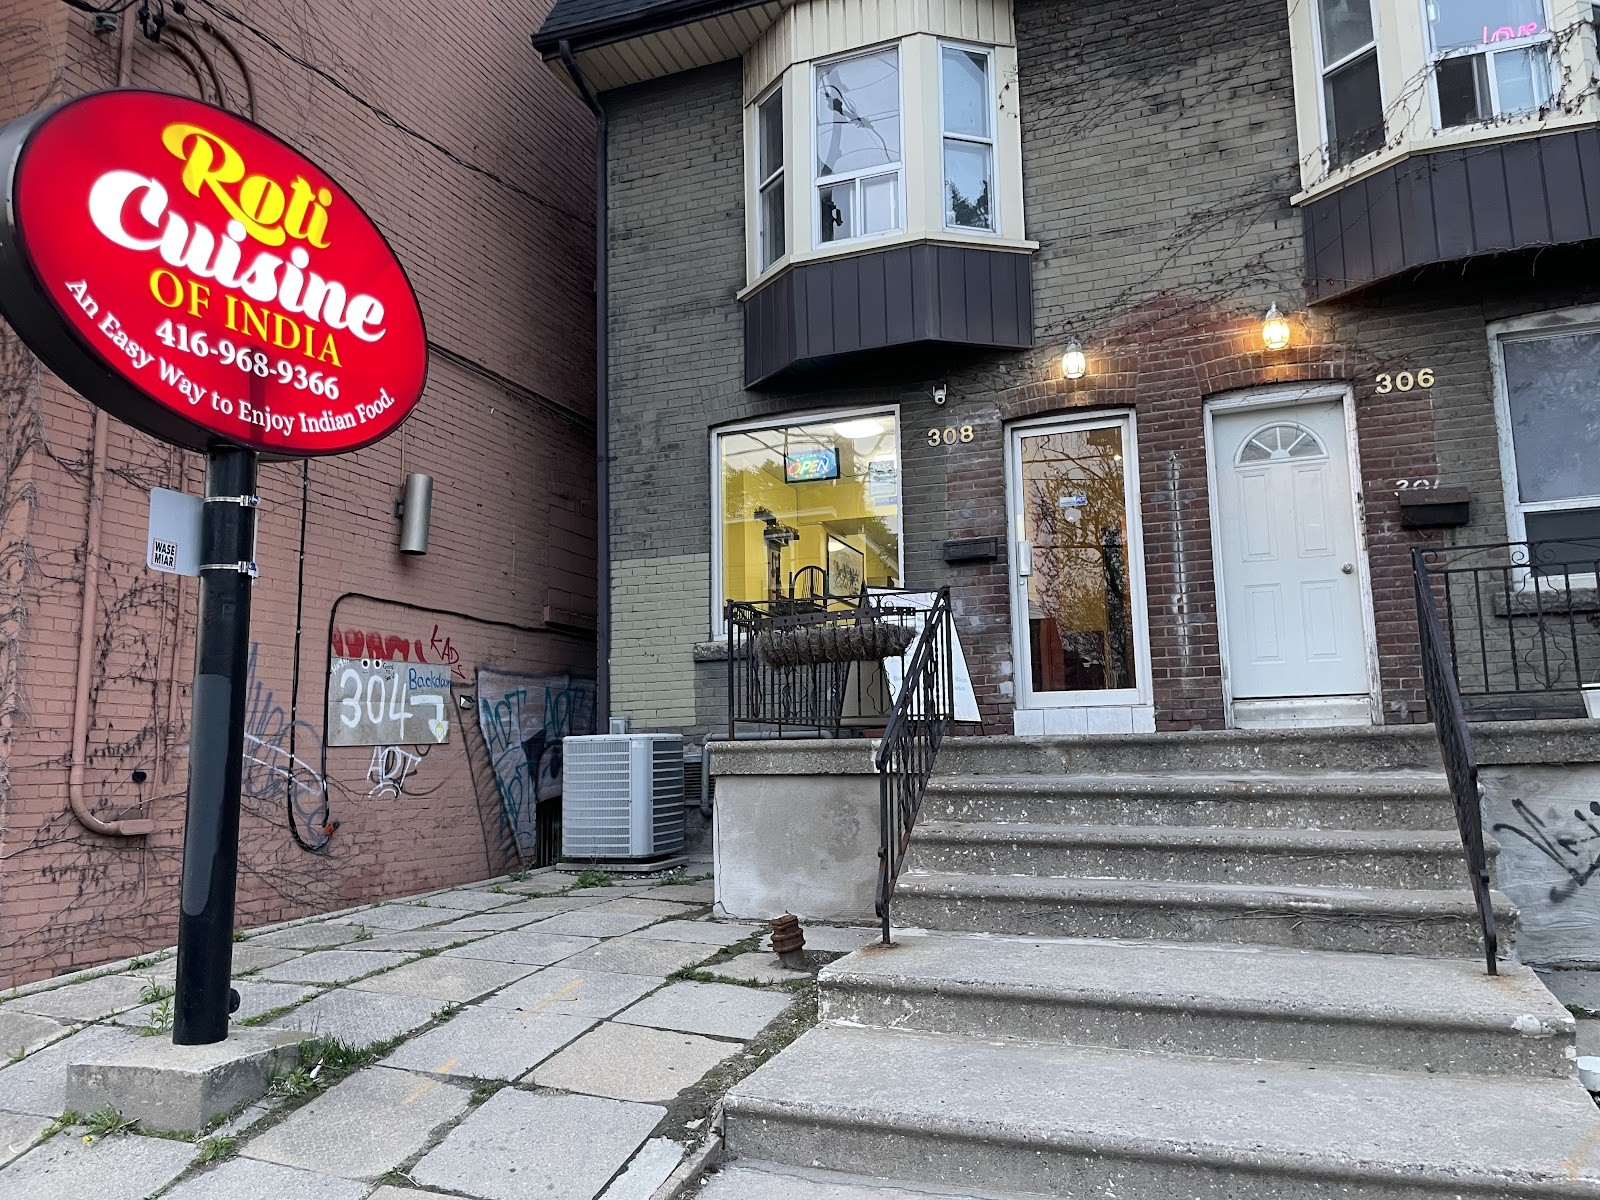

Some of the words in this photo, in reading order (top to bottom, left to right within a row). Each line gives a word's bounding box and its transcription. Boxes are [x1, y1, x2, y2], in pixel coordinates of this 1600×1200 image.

[162, 122, 333, 248] Roti
[88, 170, 386, 342] Cuisine
[149, 268, 210, 318] OF
[225, 294, 342, 368] INDIA
[64, 279, 99, 320] An
[98, 311, 155, 369] Easy
[158, 356, 207, 405] Way
[212, 391, 234, 415] to
[238, 398, 295, 437] Enjoy
[298, 410, 357, 433] Indian
[355, 387, 395, 424] Food.
[155, 318, 339, 400] 416-968-9366
[1375, 368, 1435, 394] 306
[787, 457, 830, 477] OPEN
[928, 425, 974, 447] 308
[154, 553, 174, 567] MIAR
[155, 541, 175, 556] WASE
[340, 668, 413, 740] 304
